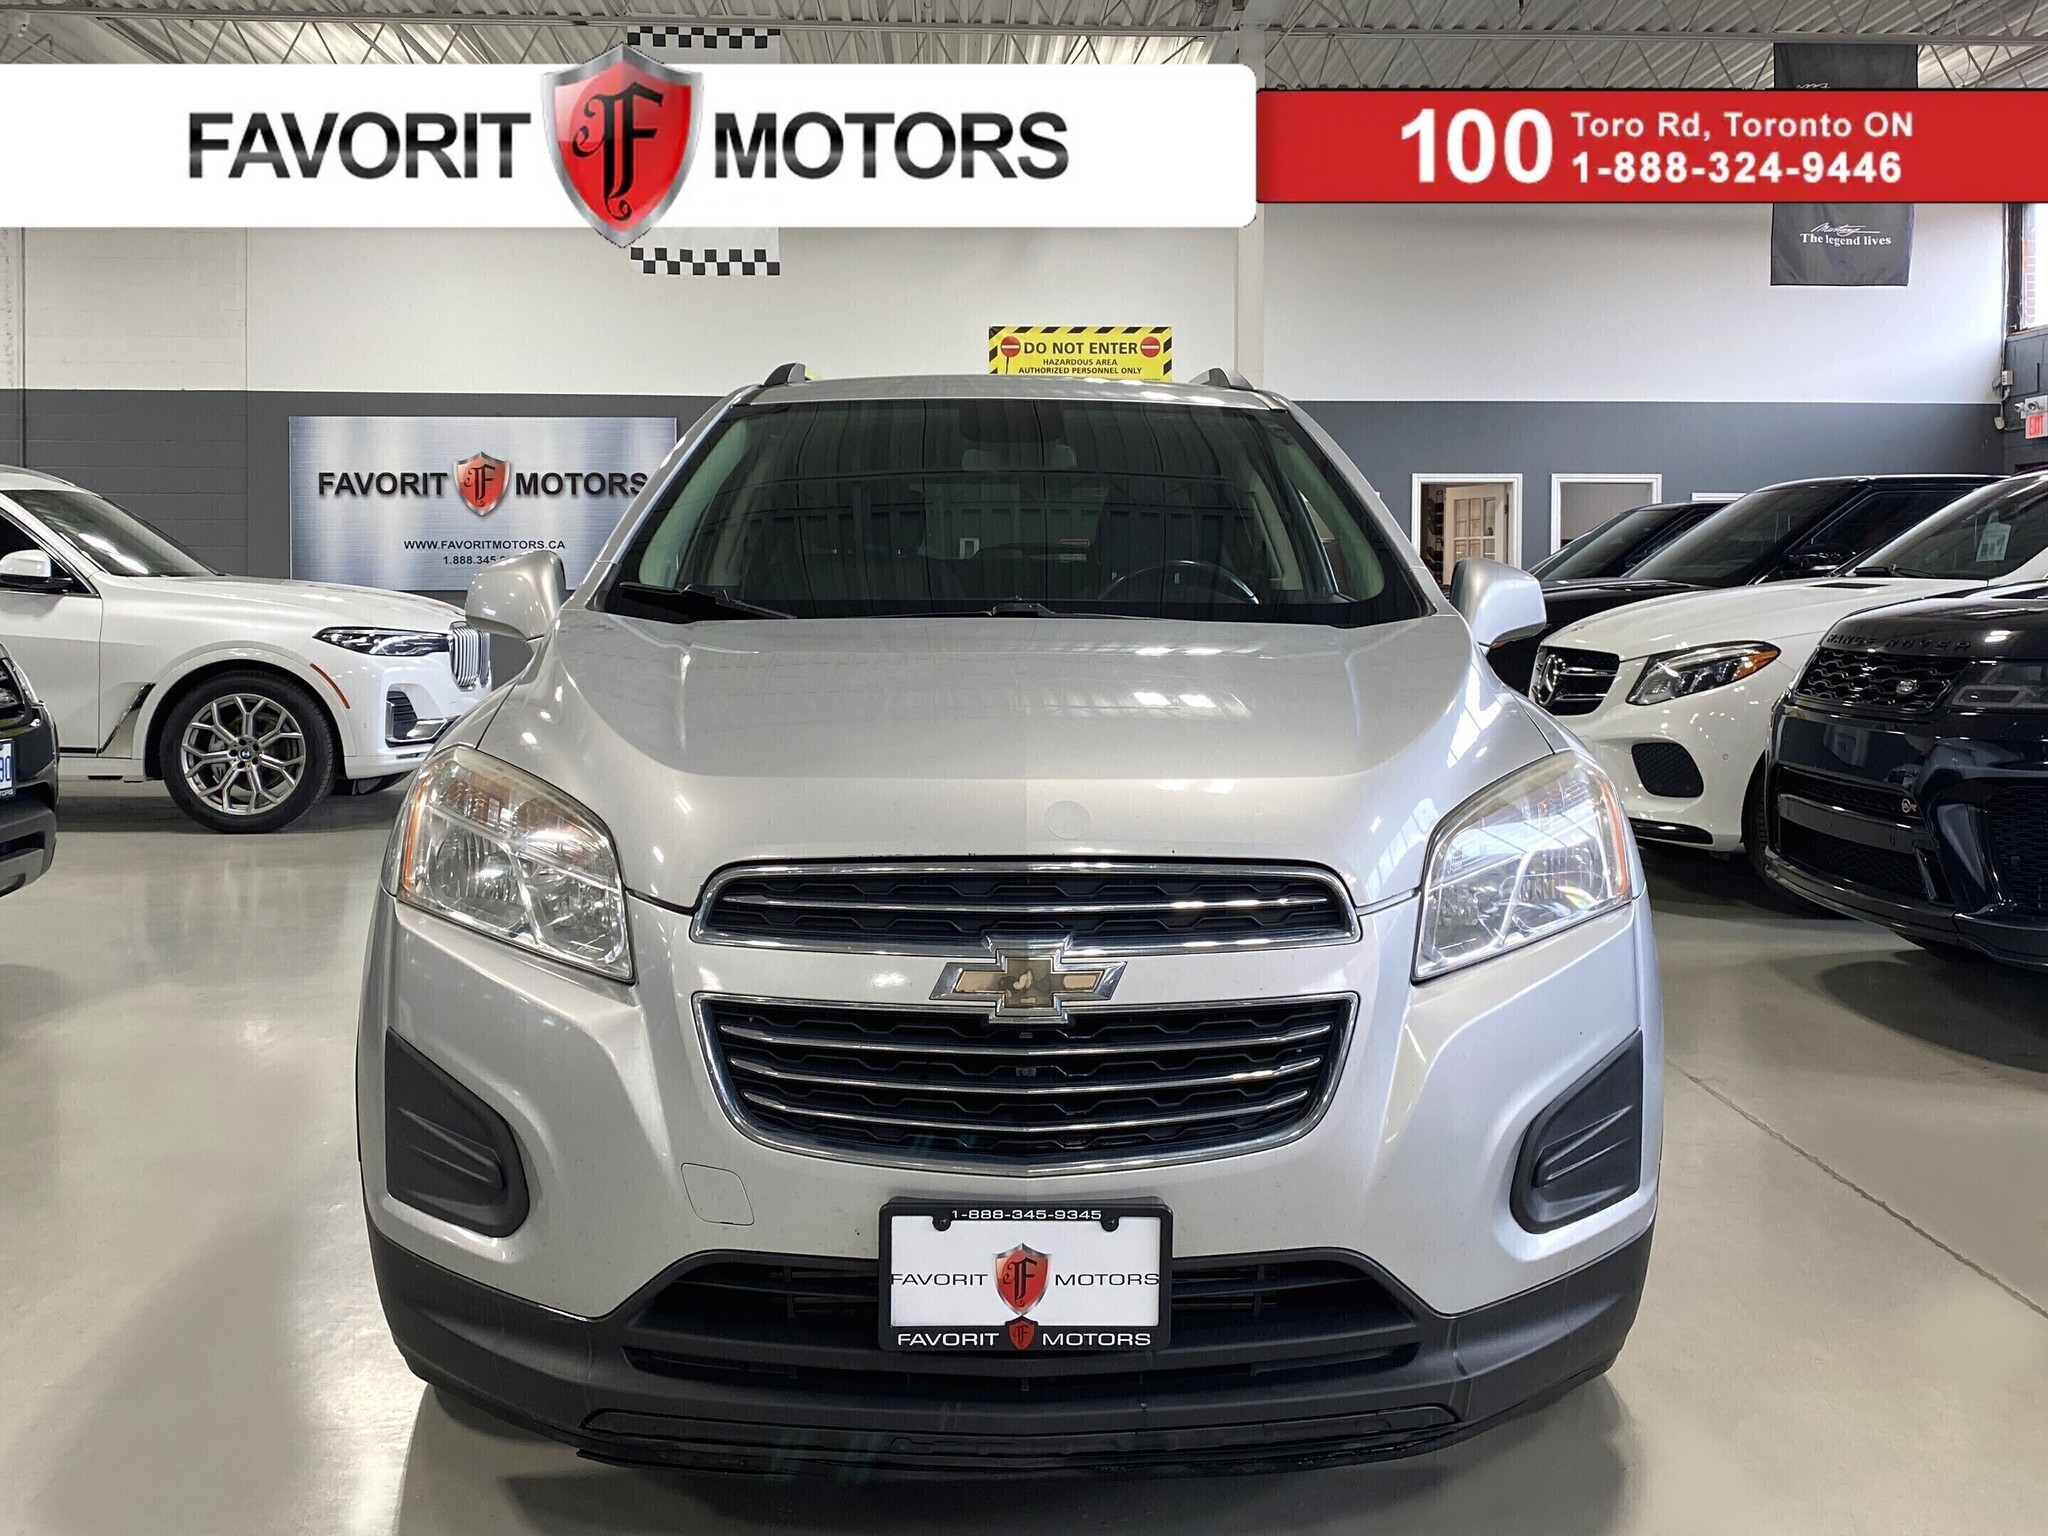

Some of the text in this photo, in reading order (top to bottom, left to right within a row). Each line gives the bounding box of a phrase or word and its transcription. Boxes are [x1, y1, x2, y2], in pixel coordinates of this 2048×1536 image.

[1800, 233, 1892, 247] The legend lives
[1024, 342, 1138, 354] DO NOT ENTER
[1043, 358, 1118, 366] HAZARDOUS AREA
[318, 472, 448, 496] FAVORIT
[515, 472, 649, 496] MOTORS
[403, 540, 566, 550] WWW.FAVORITMOTORS.CA
[951, 1209, 1102, 1220] 1-888-345-9345
[890, 1273, 989, 1286] FAVORIT
[1054, 1273, 1160, 1286] MOTORS
[897, 1333, 1000, 1346] FAVORIT
[1042, 1332, 1151, 1346] MOTORS
